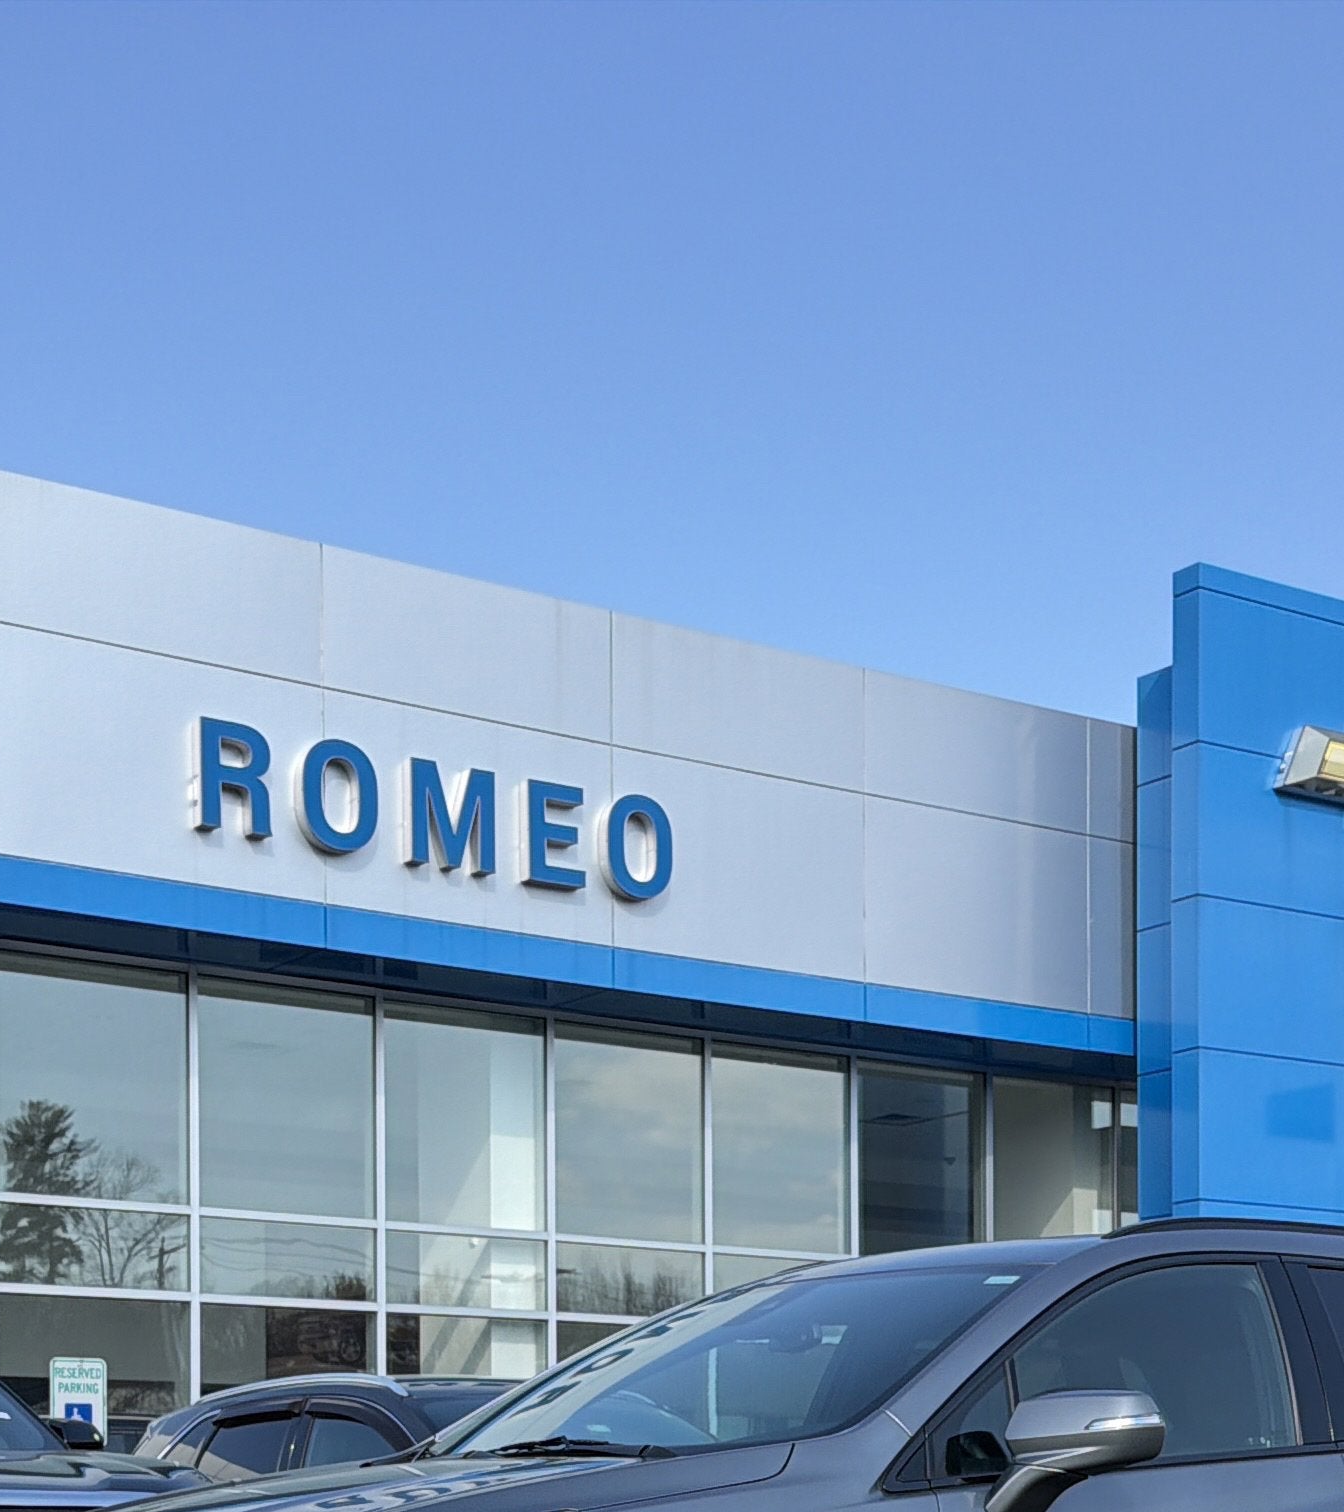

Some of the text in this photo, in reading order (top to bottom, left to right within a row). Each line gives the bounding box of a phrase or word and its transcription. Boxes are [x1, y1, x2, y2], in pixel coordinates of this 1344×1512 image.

[192, 715, 673, 901] ROMEO
[54, 1367, 102, 1380] RESERVED
[58, 1382, 99, 1394] PARKING
